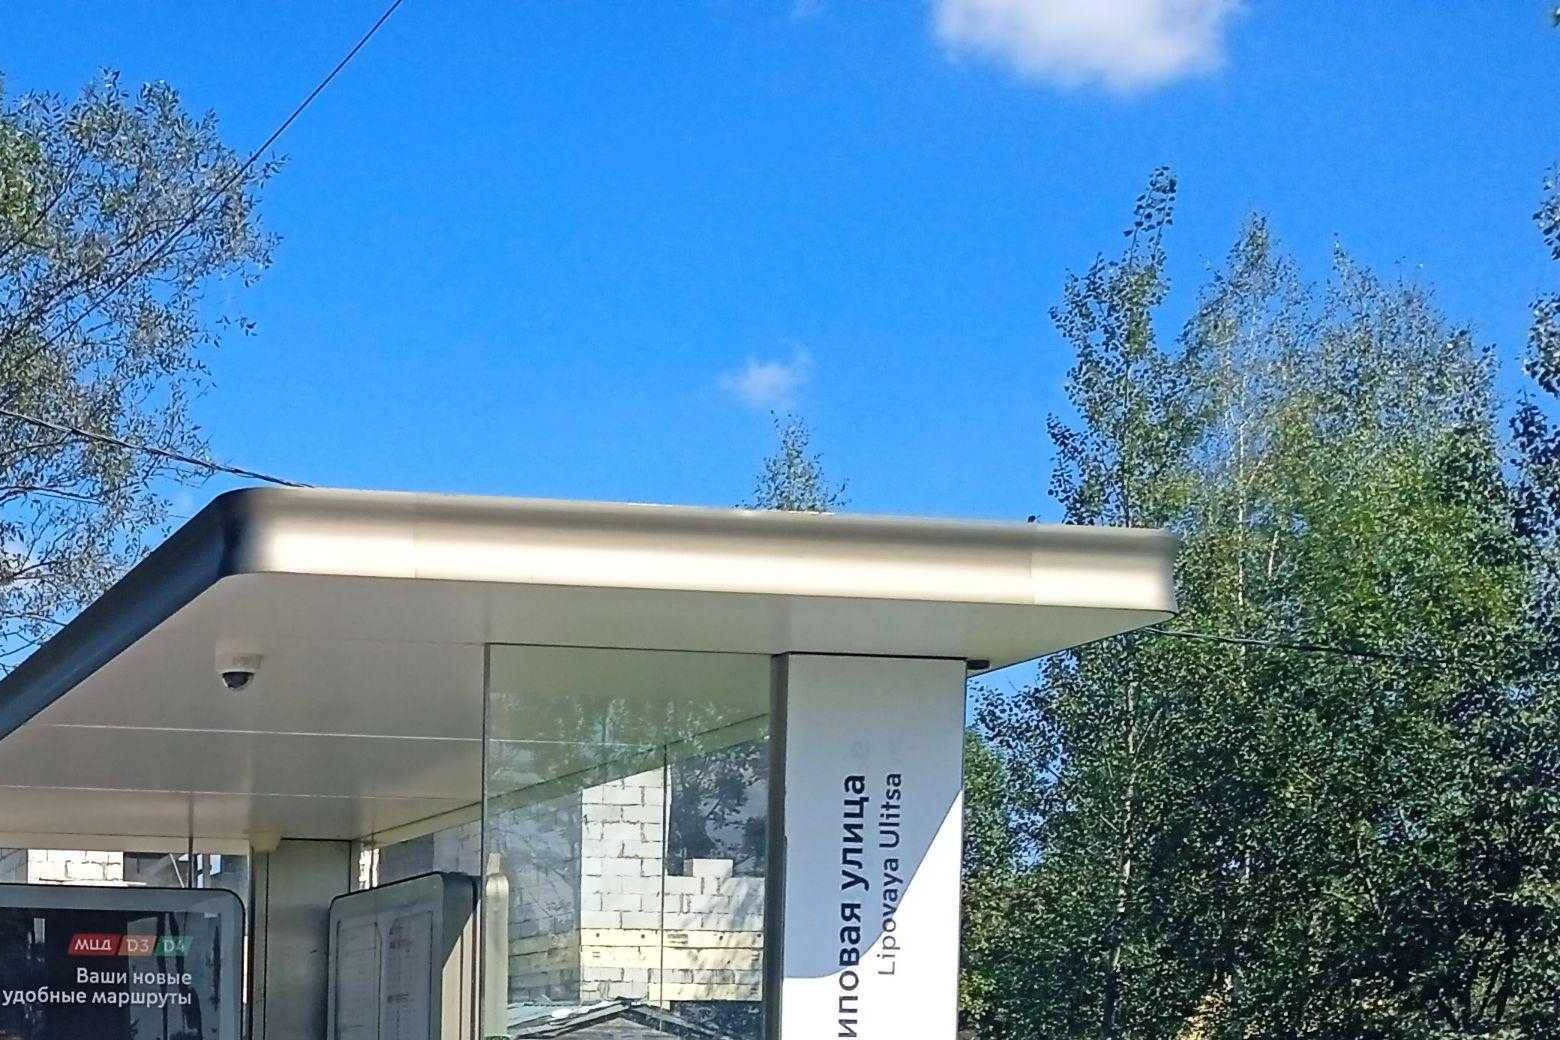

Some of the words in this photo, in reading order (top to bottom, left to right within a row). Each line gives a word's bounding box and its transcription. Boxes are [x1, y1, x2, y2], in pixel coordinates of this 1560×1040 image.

[878, 773, 903, 848] Ulitsa
[841, 775, 869, 892] улица
[877, 857, 904, 976] Lipovaya
[75, 938, 112, 952] МЦД
[127, 938, 149, 952] D3
[76, 967, 127, 984] Ваши
[133, 972, 192, 986] новые
[1, 986, 87, 1007] удобные
[91, 990, 192, 1009] маршруты
